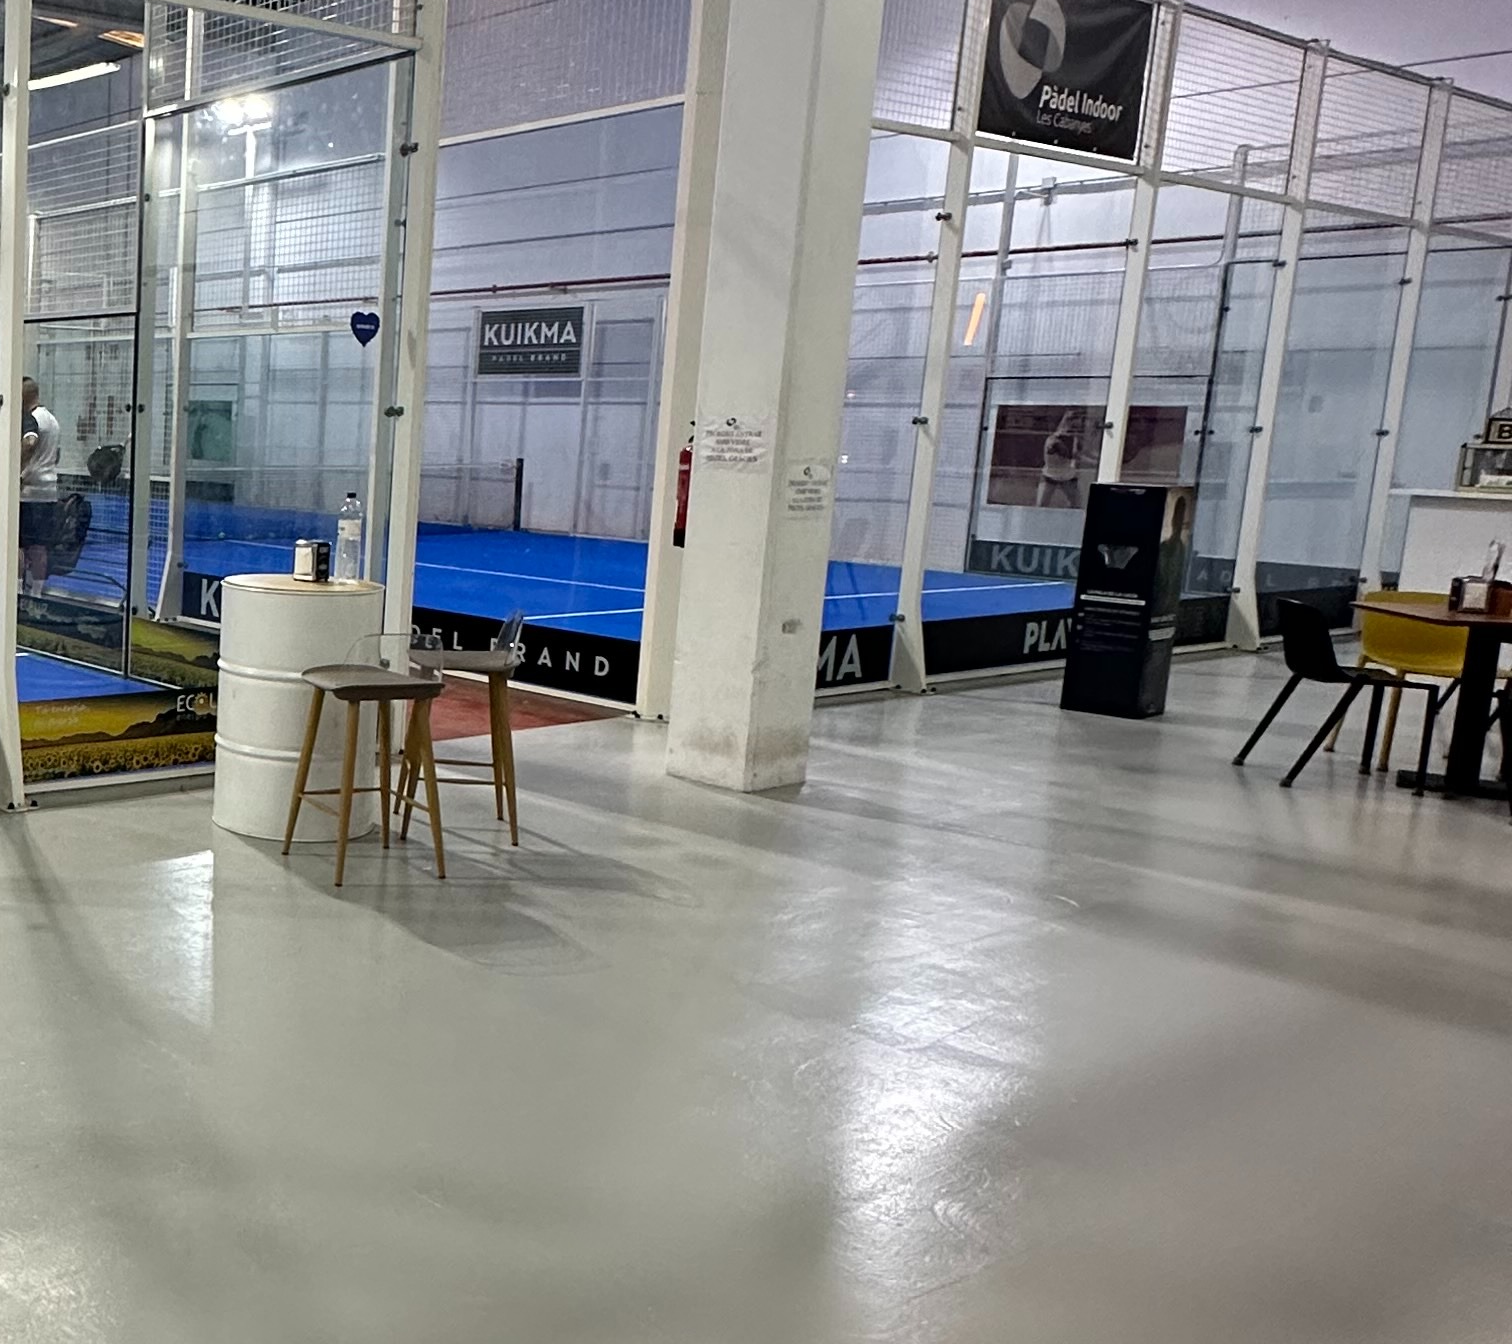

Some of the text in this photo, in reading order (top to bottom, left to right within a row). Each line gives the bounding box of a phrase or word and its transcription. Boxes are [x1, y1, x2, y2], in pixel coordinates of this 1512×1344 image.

[1036, 109, 1052, 126] Les
[1038, 84, 1123, 122] Pàdel Indoor
[484, 321, 577, 346] KUIKMA
[990, 543, 1080, 576] KUIK
[1023, 617, 1073, 654] PLA
